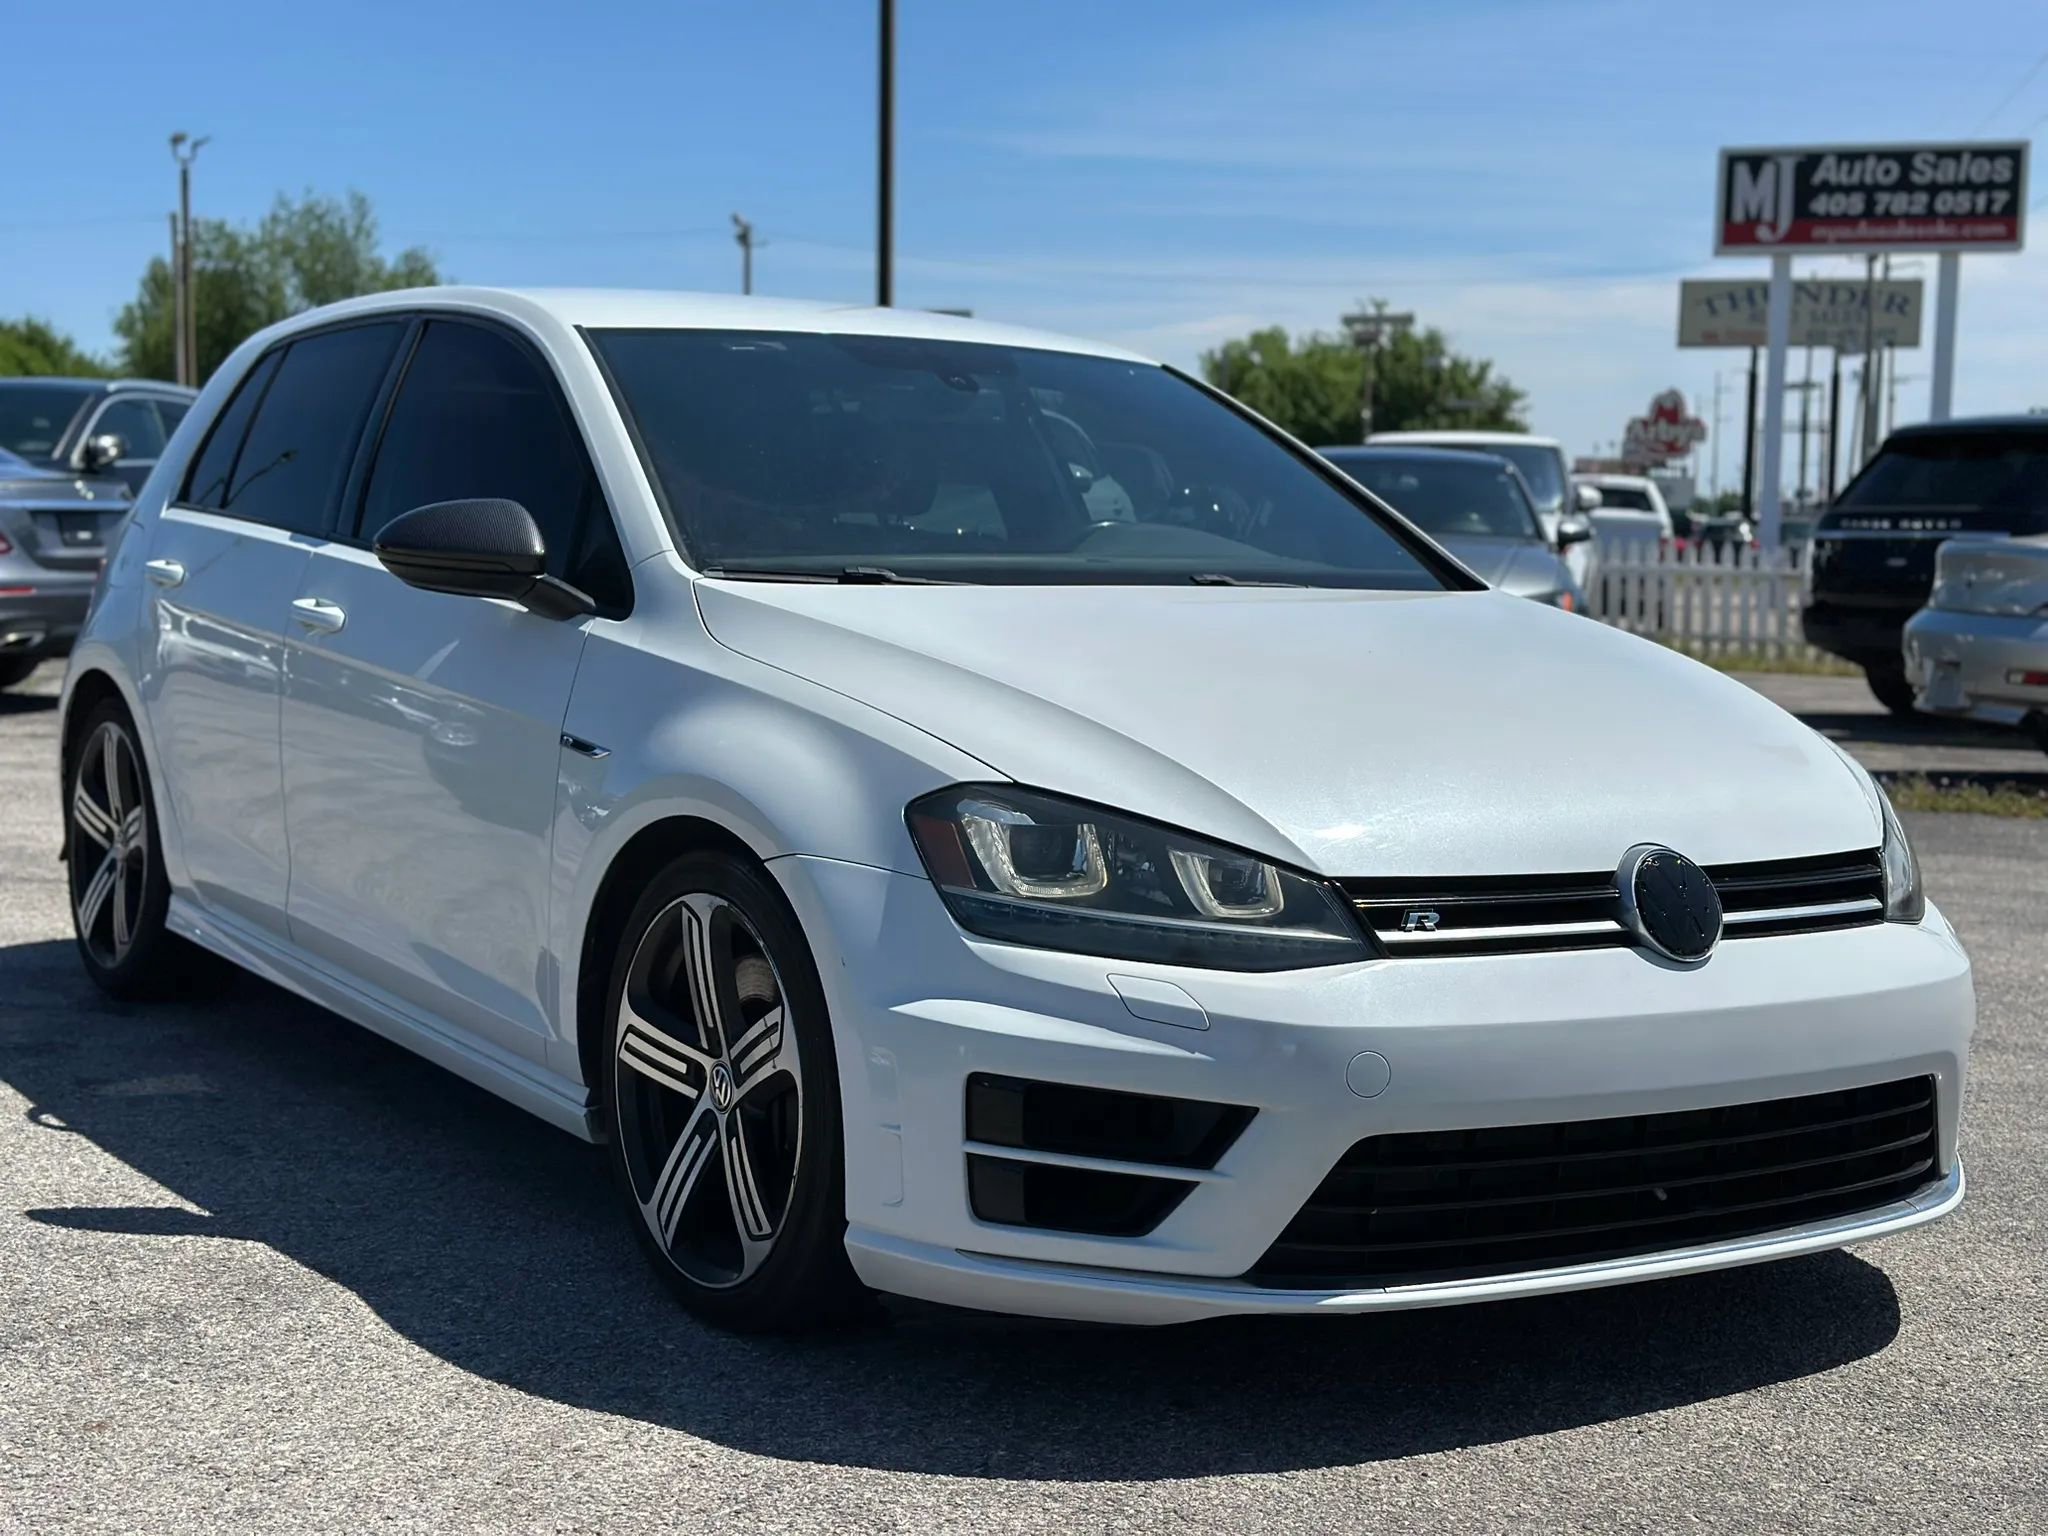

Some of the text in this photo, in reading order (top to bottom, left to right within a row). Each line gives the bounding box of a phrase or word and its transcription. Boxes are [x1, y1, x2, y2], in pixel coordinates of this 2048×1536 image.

[1809, 152, 2014, 186] Auto Sales
[1731, 156, 1806, 242] MJ
[1808, 192, 1867, 216] 405
[1403, 911, 1440, 931] R
